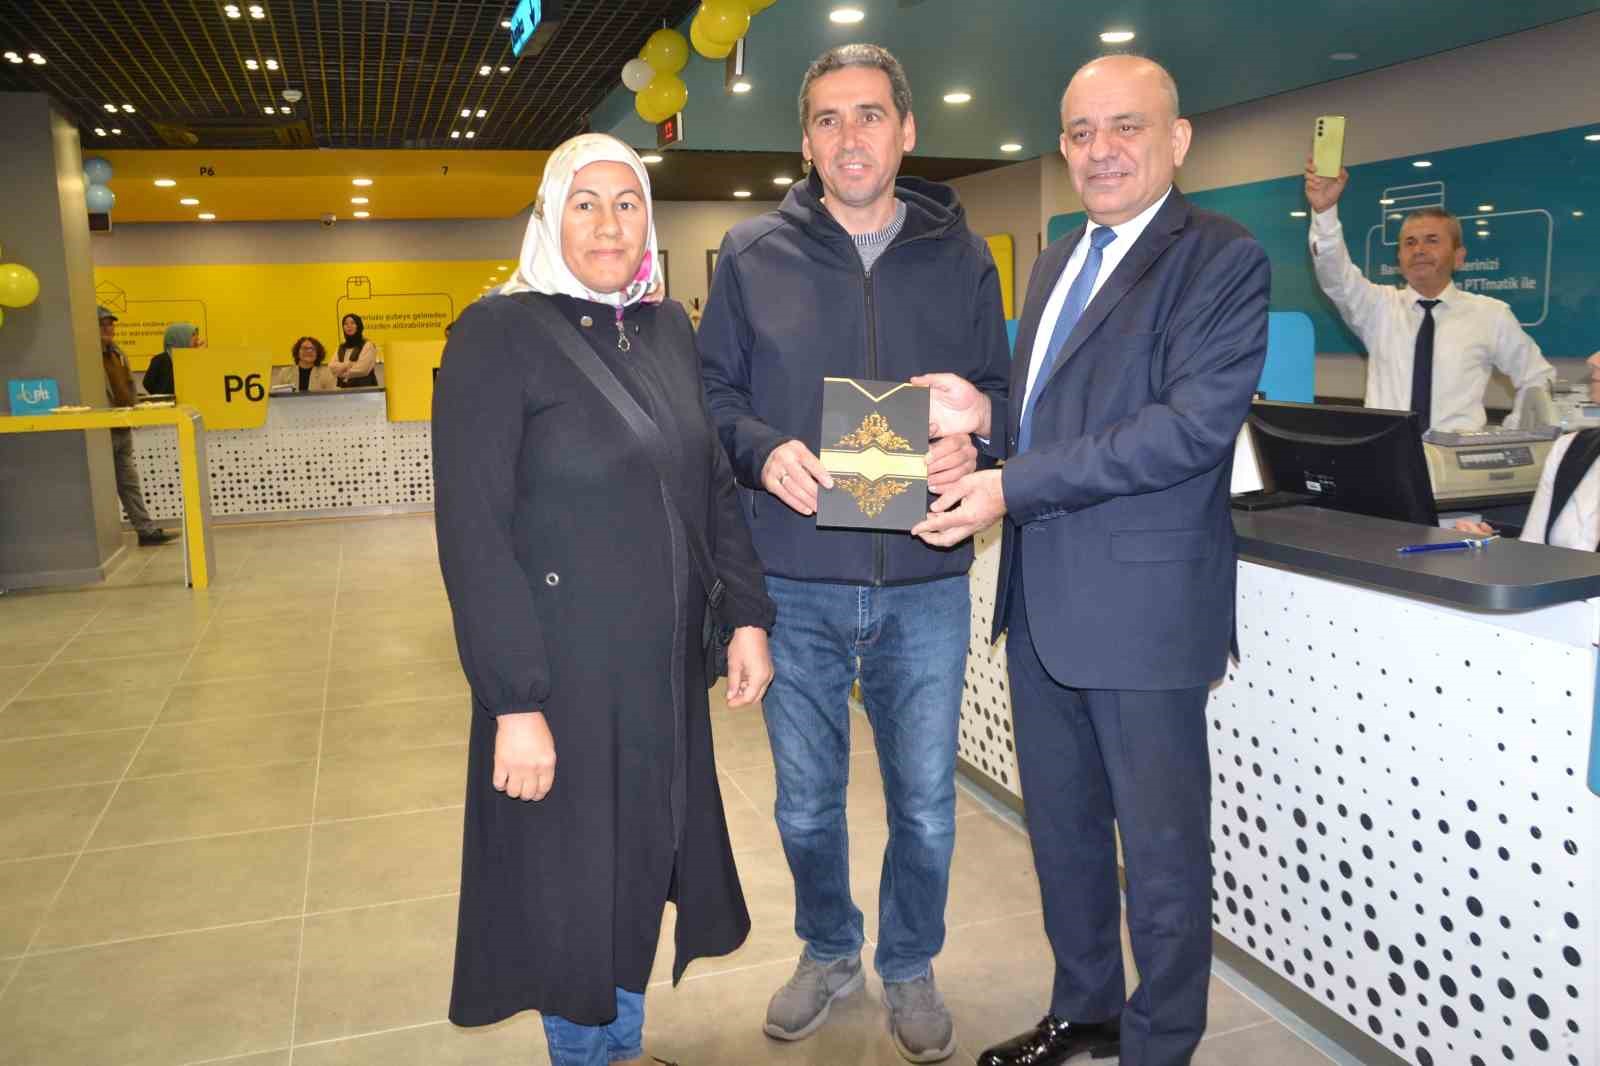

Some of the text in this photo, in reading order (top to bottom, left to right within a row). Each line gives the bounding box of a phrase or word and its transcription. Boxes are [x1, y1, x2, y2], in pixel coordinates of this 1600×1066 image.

[199, 166, 215, 177] P6
[1465, 277, 1518, 290] PTTmatik
[1521, 276, 1536, 289] ile
[223, 372, 265, 402] P6
